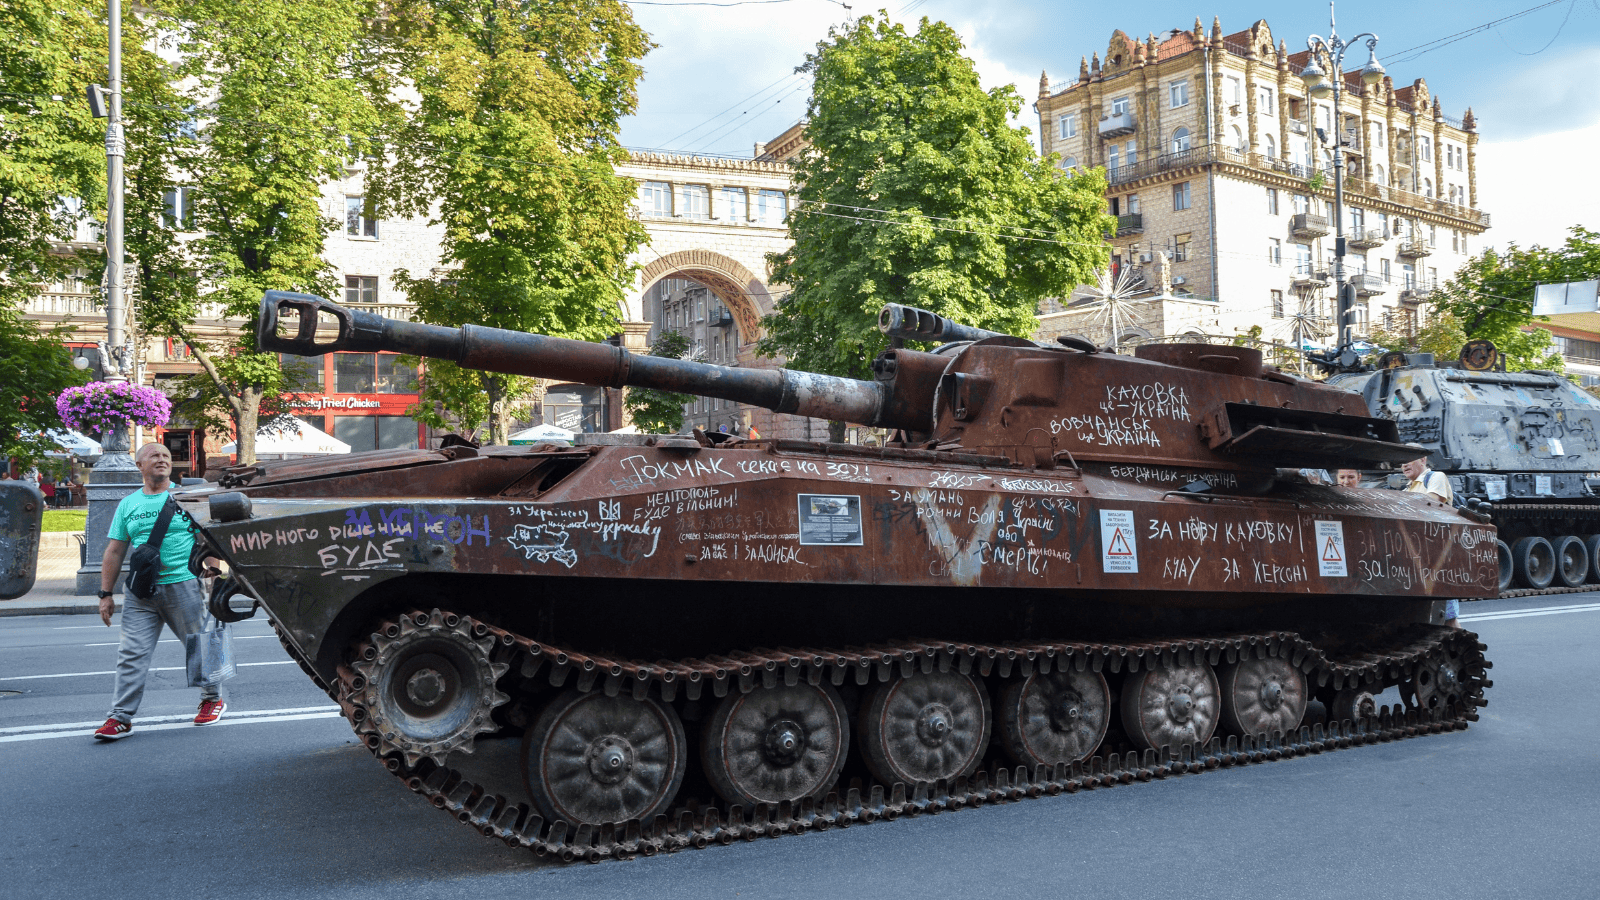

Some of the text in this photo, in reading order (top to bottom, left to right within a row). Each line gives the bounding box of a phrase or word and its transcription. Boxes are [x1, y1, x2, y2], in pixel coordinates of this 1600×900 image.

[322, 397, 346, 408] Fried
[346, 396, 380, 408] Chicken
[129, 509, 161, 521] Reebo
